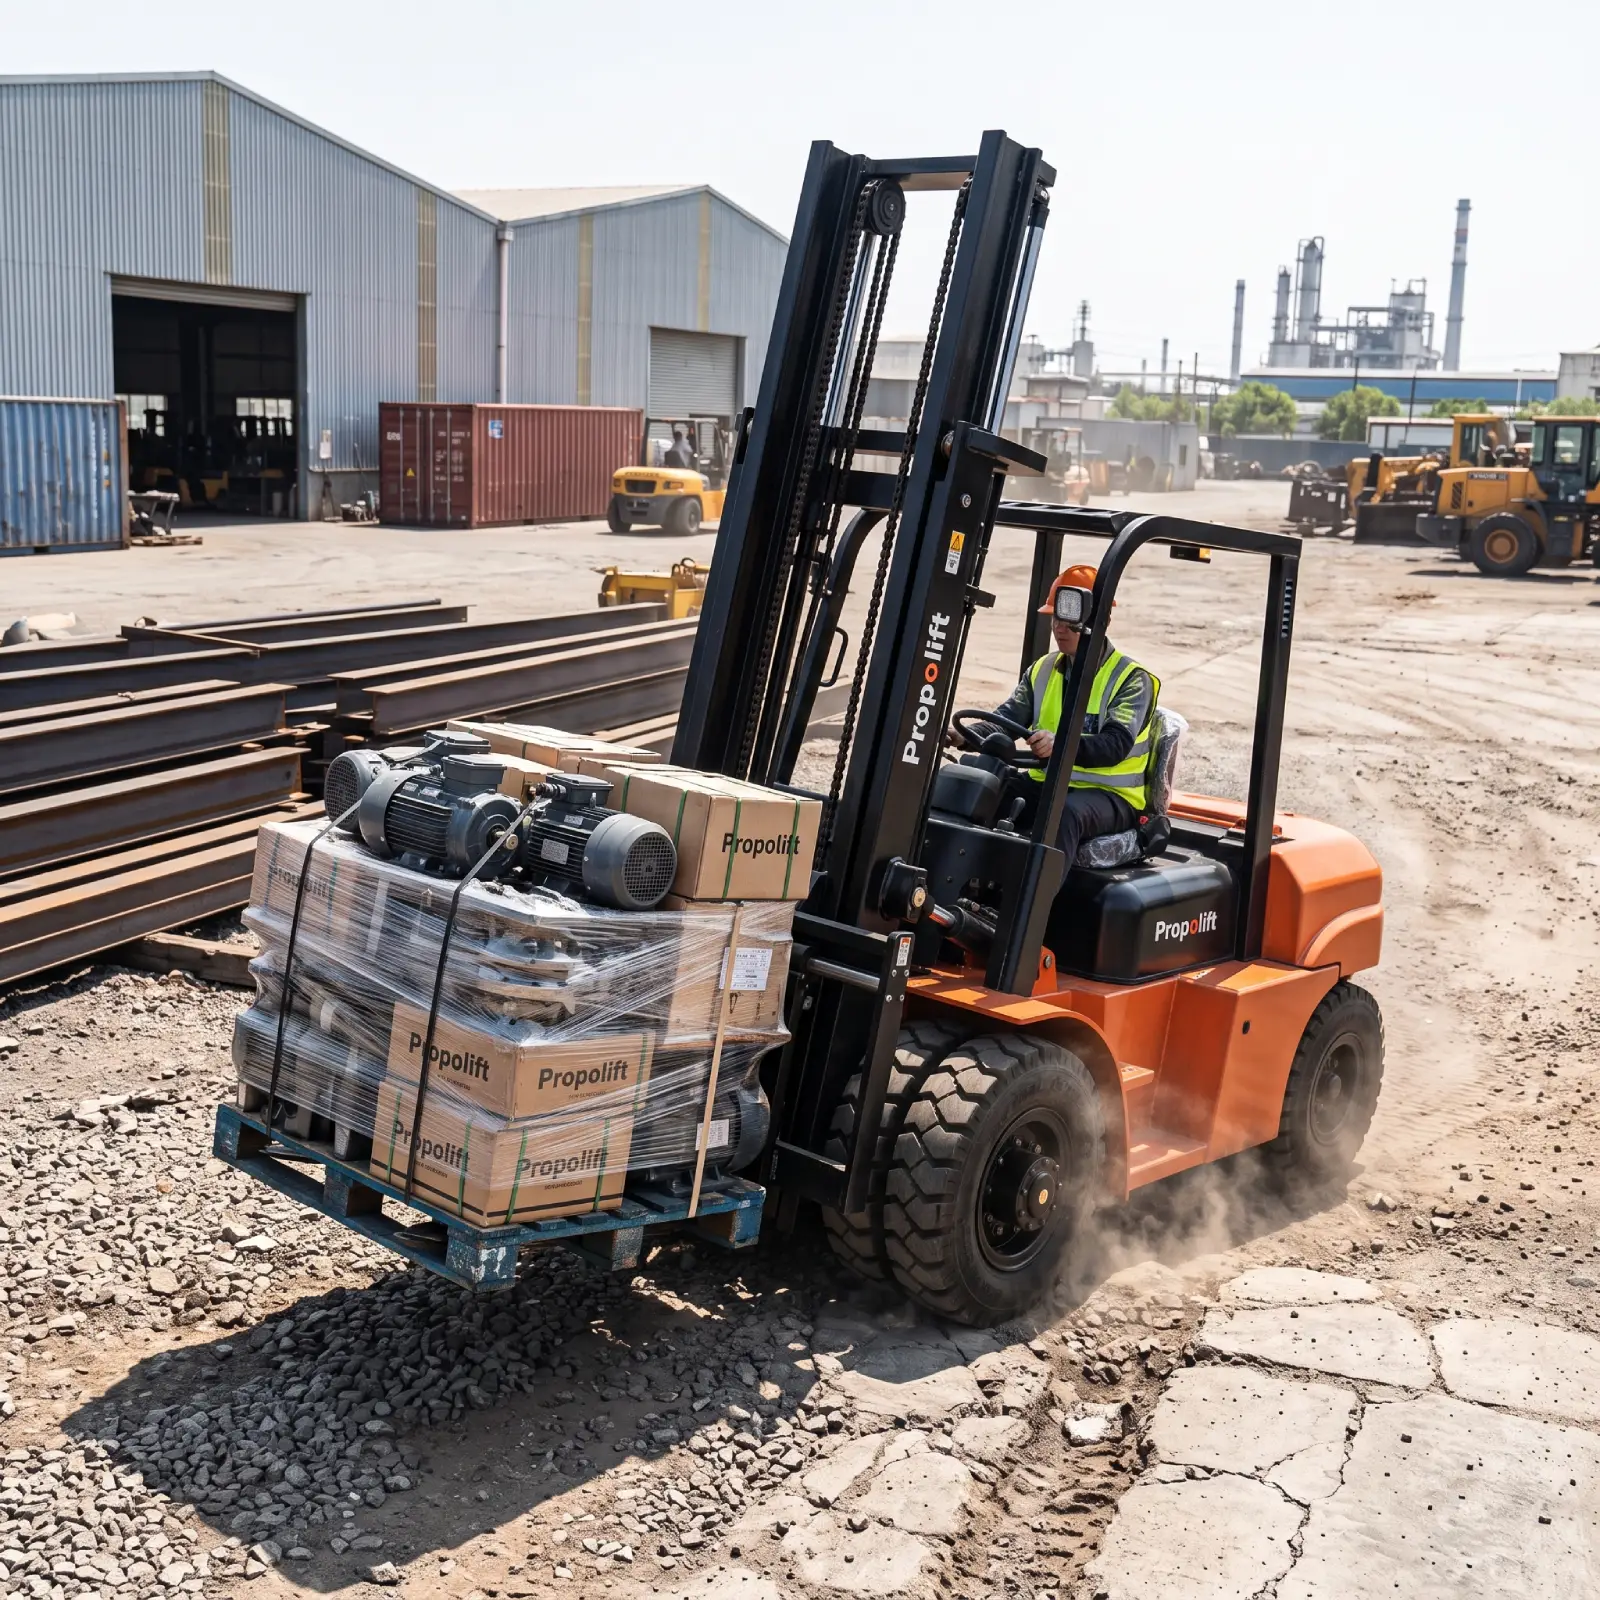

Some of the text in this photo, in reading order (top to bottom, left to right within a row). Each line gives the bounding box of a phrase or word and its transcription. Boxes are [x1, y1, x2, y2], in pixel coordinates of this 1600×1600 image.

[902, 612, 950, 765] Propolift
[722, 832, 800, 859] Propolift
[1154, 910, 1218, 942] Propolift
[538, 1060, 628, 1090] Propolift
